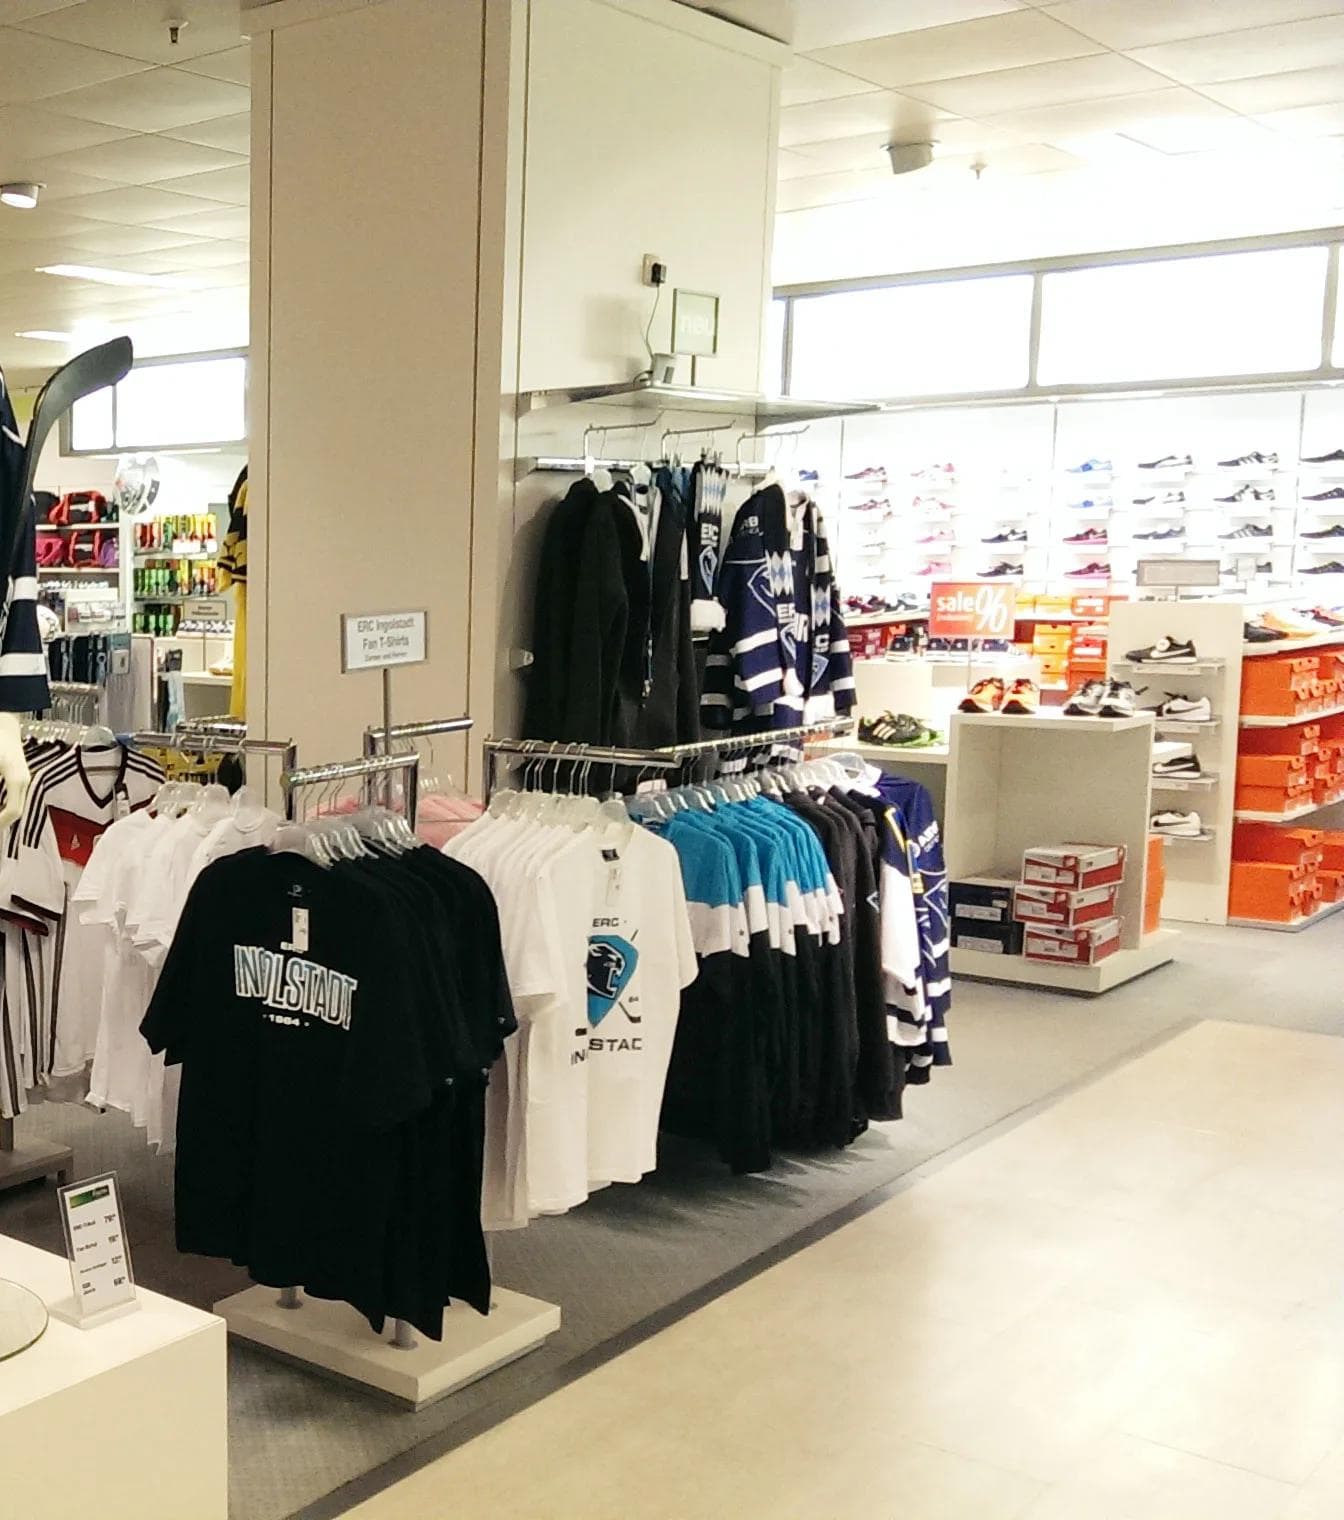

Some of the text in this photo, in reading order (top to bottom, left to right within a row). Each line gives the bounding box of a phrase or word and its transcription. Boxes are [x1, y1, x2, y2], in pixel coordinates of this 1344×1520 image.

[937, 591, 975, 613] sale
[357, 620, 374, 632] ERC
[362, 638, 377, 650] Fan
[592, 918, 620, 928] ERC
